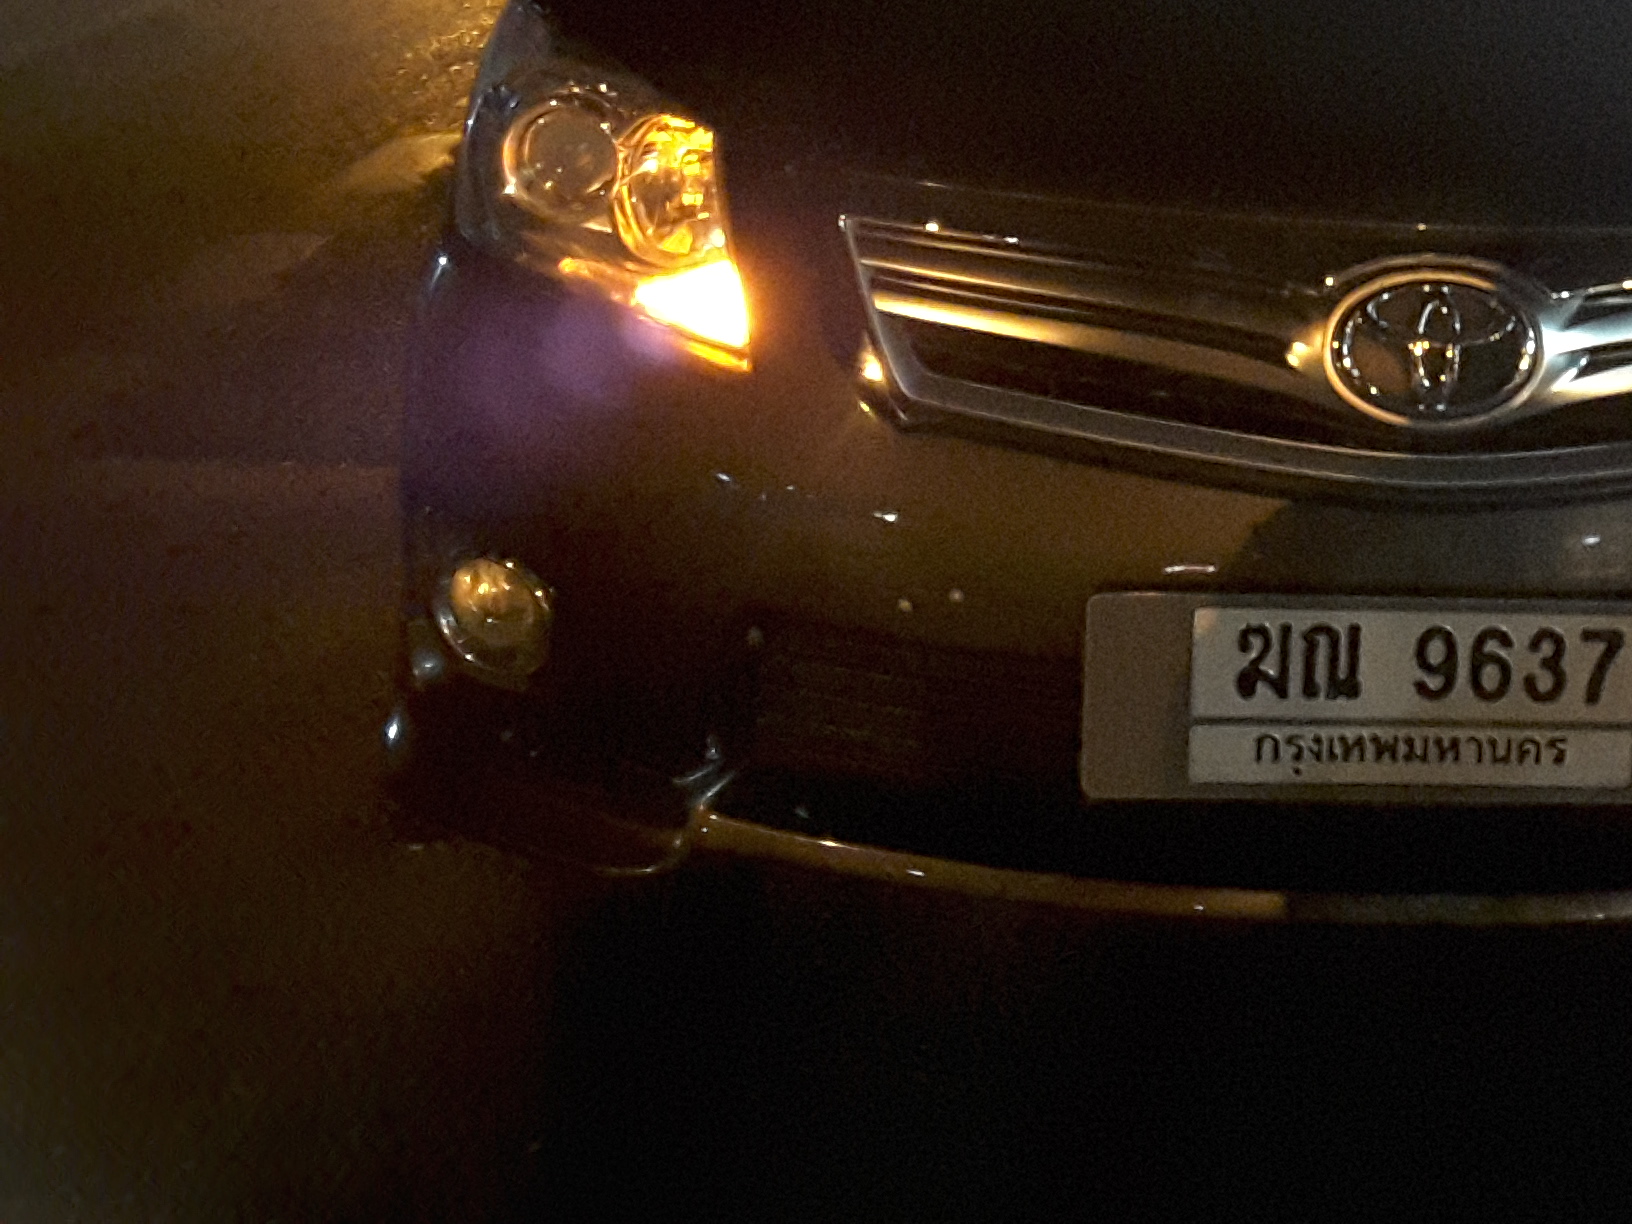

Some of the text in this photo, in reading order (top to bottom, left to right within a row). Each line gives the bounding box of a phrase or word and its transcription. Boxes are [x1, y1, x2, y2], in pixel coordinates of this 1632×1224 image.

[1412, 626, 1625, 705] 9637
[1254, 733, 1568, 775] กรุงเทพมหานคร
